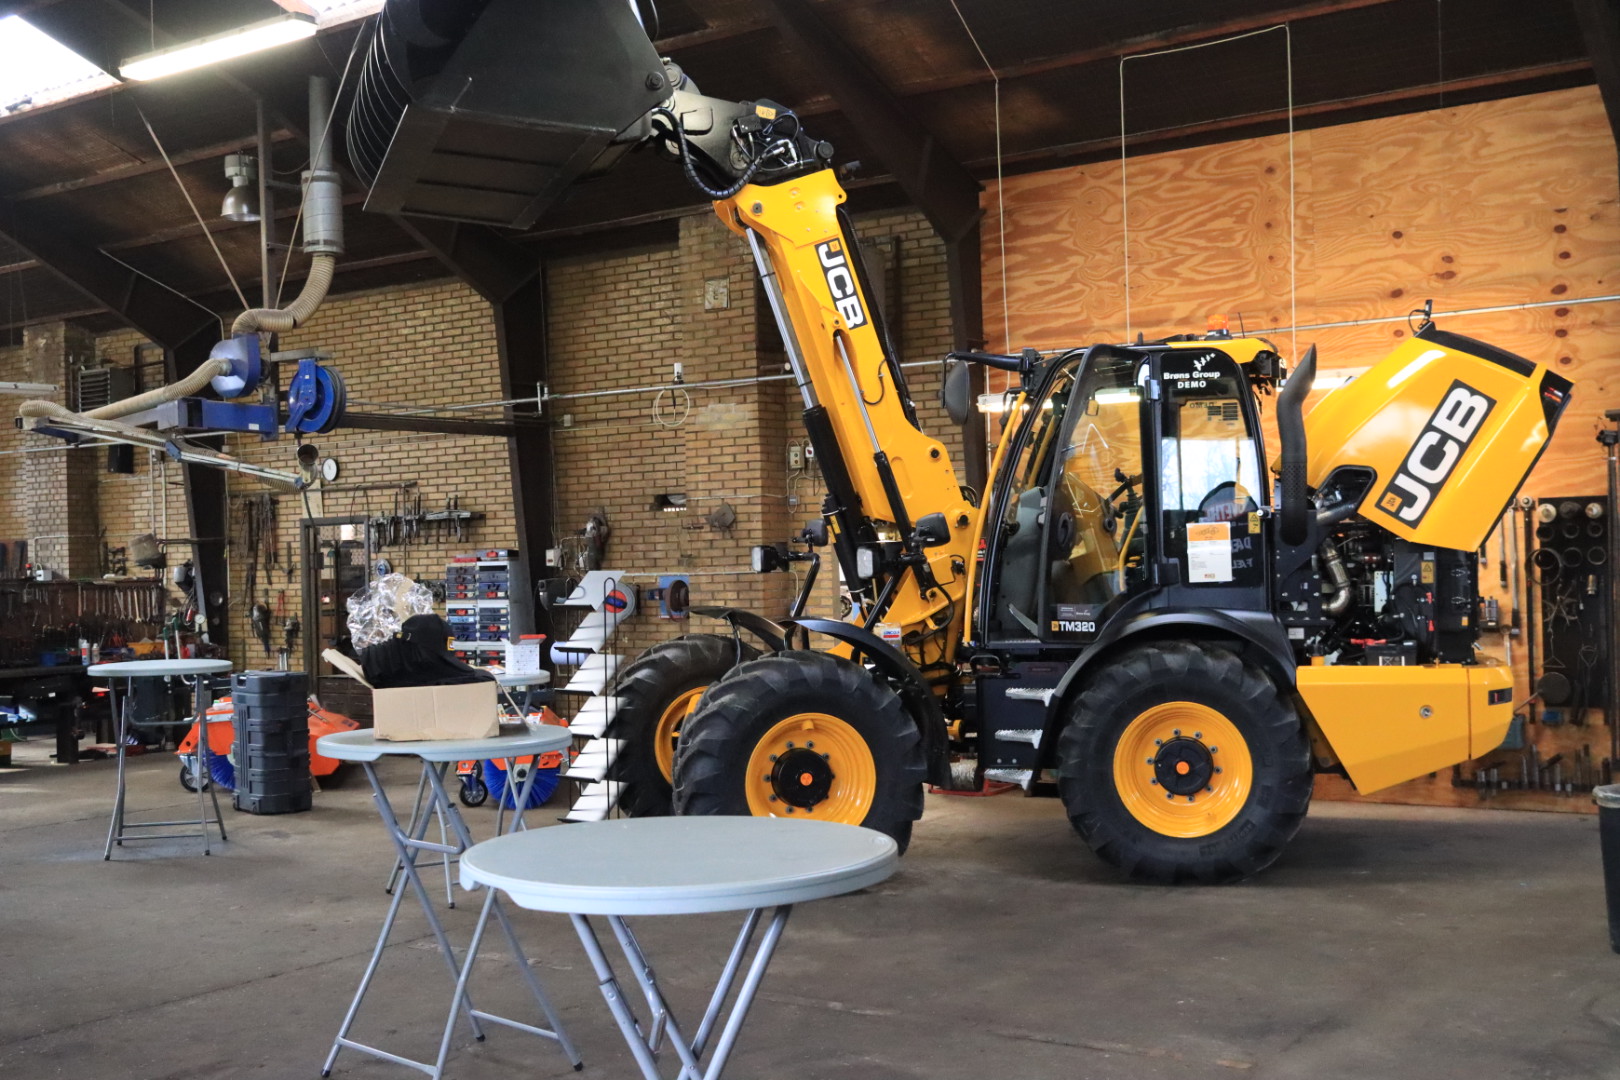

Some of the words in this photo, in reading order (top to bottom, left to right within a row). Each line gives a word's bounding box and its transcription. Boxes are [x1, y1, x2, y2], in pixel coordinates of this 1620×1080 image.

[817, 243, 864, 329] JCB
[1163, 372, 1190, 380] Brøns
[1192, 371, 1221, 379] Group
[1177, 380, 1207, 389] DEMO
[1394, 387, 1489, 522] JCB
[1059, 621, 1096, 632] TM320
